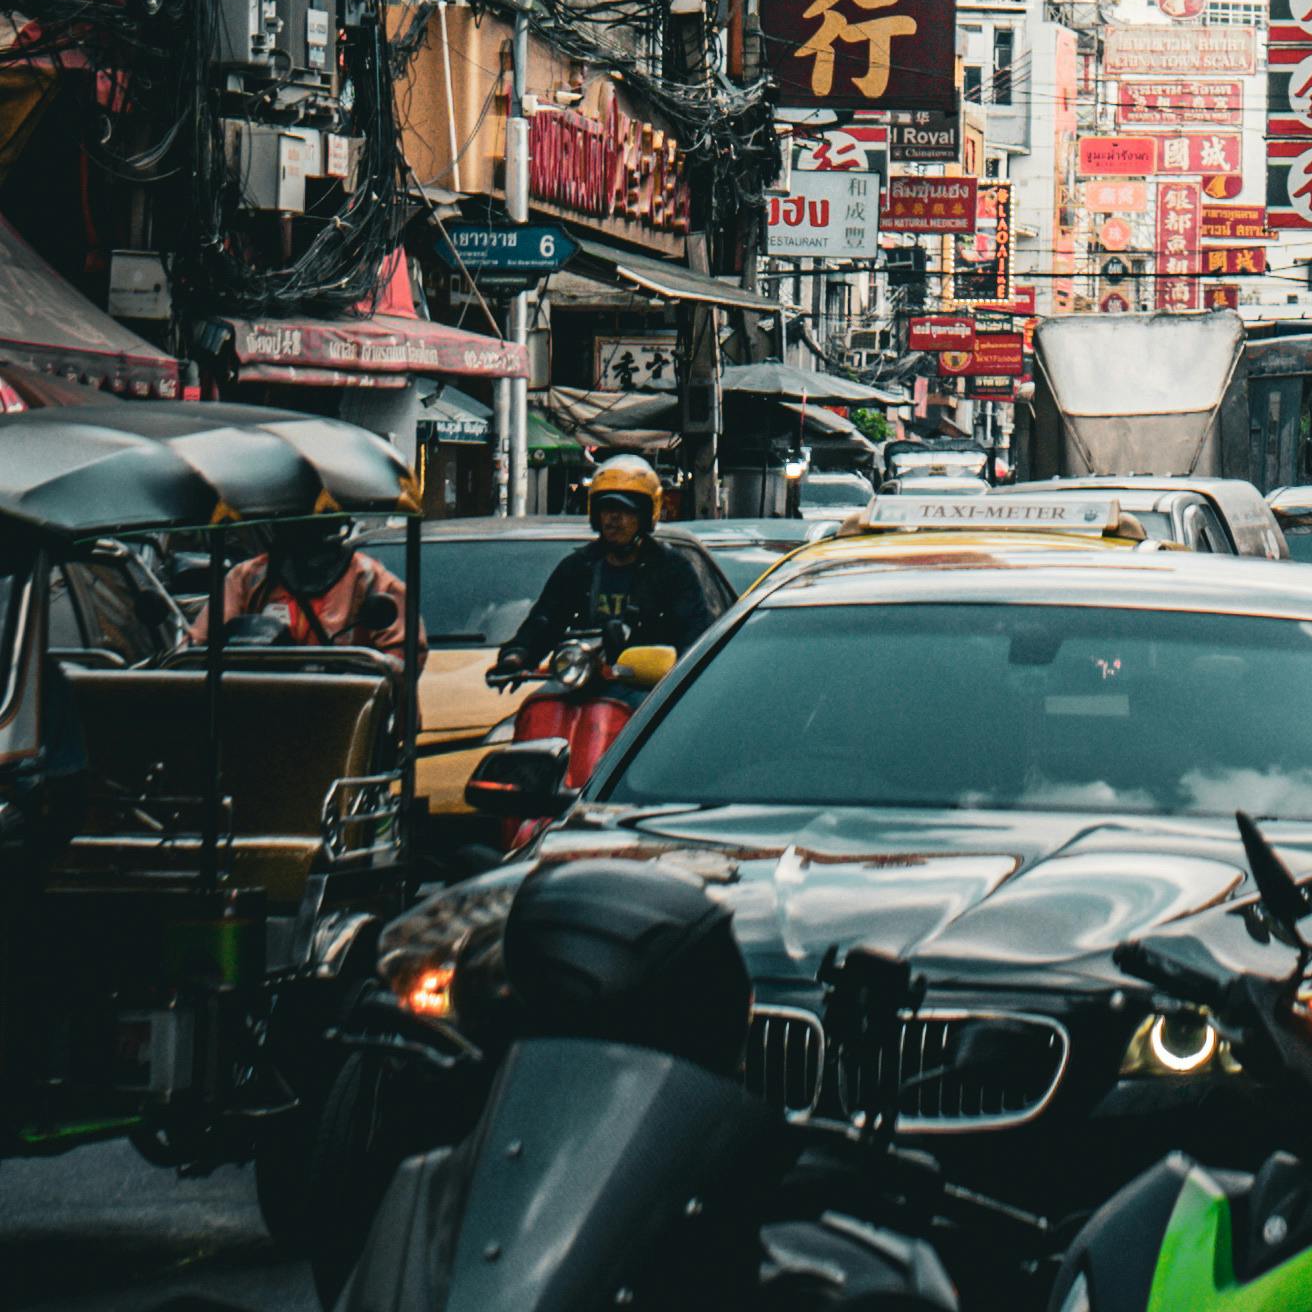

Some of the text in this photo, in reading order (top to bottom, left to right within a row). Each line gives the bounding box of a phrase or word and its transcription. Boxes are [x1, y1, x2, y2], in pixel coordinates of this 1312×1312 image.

[1203, 56, 1248, 67] SCALA
[903, 127, 955, 146] Royal
[453, 231, 556, 258] เยาวราช 6
[919, 503, 1067, 521] TAXI-METER
